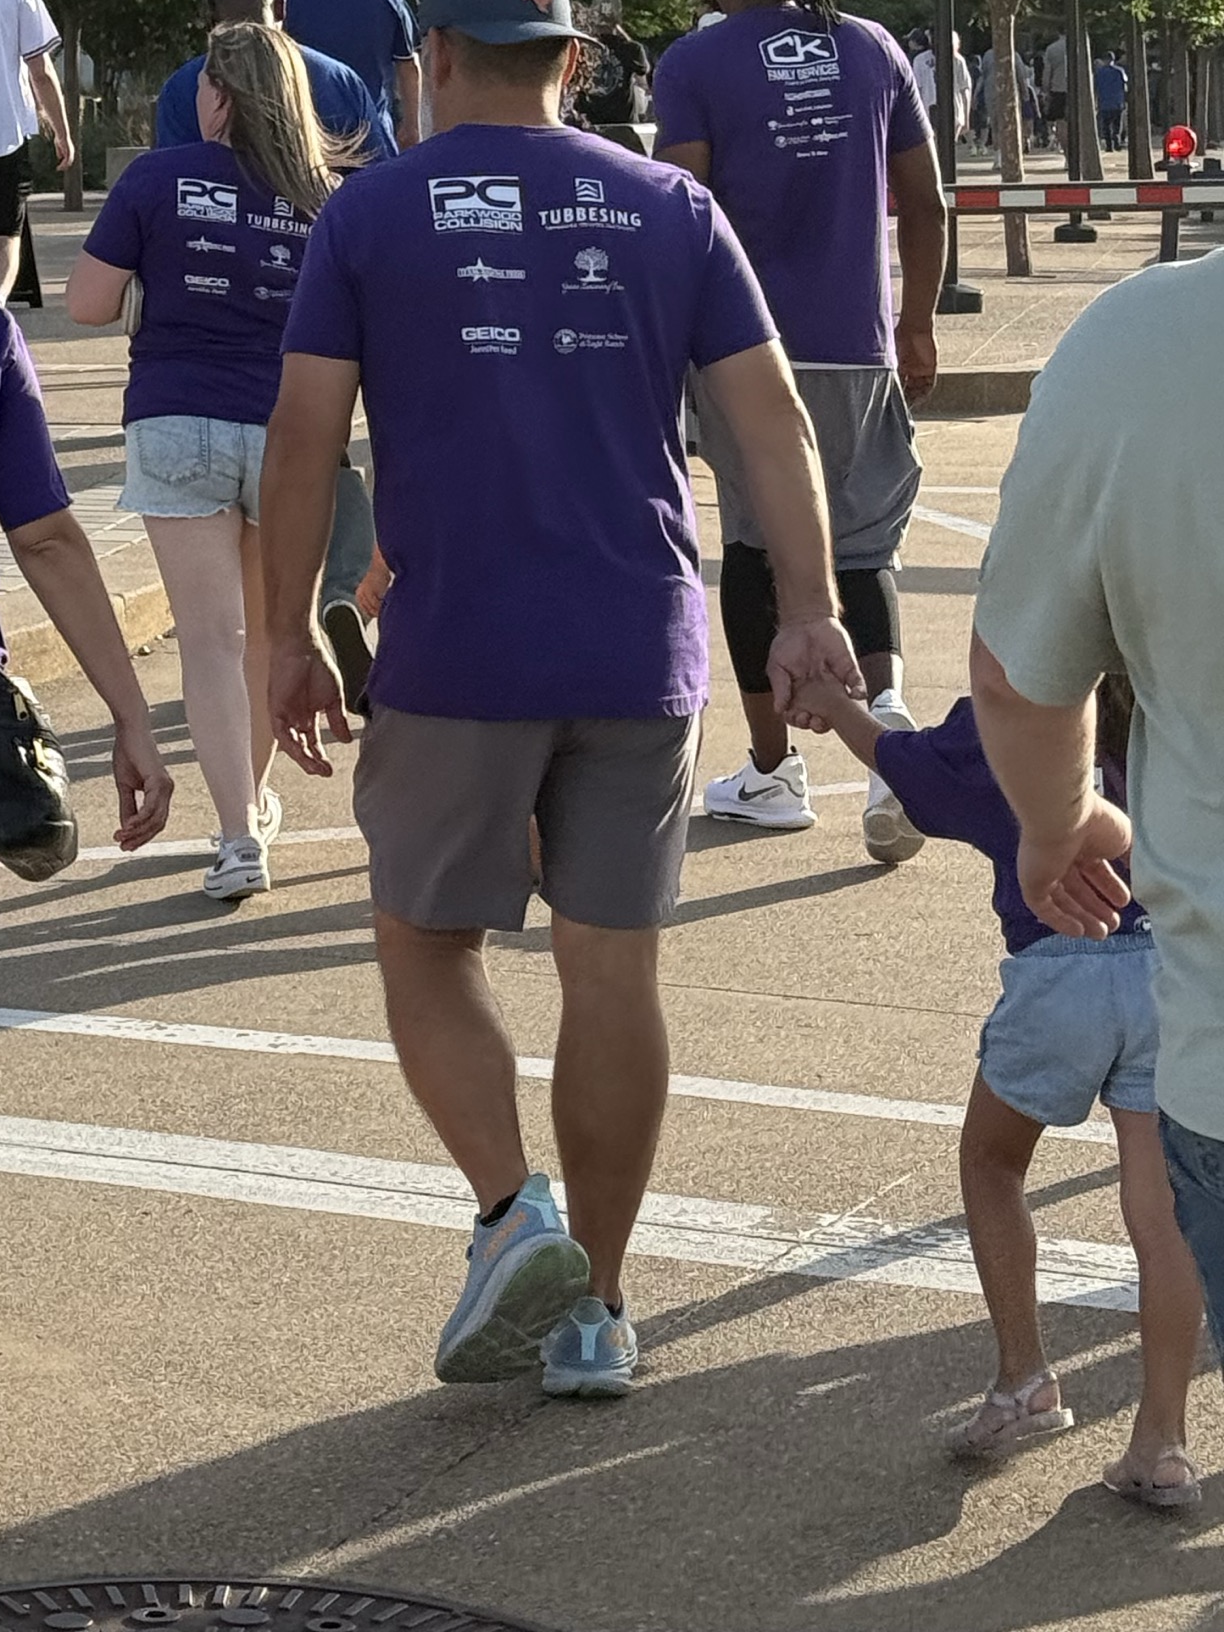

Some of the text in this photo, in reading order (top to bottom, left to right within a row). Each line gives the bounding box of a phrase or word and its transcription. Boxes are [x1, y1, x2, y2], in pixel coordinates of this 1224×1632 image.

[767, 34, 831, 63] CK
[432, 178, 520, 212] PC
[433, 209, 522, 222] PARKWOOD
[538, 207, 642, 227] TUBBESING
[434, 217, 523, 232] COLLISION
[184, 274, 229, 287] GEICO
[461, 326, 520, 342] GEICO
